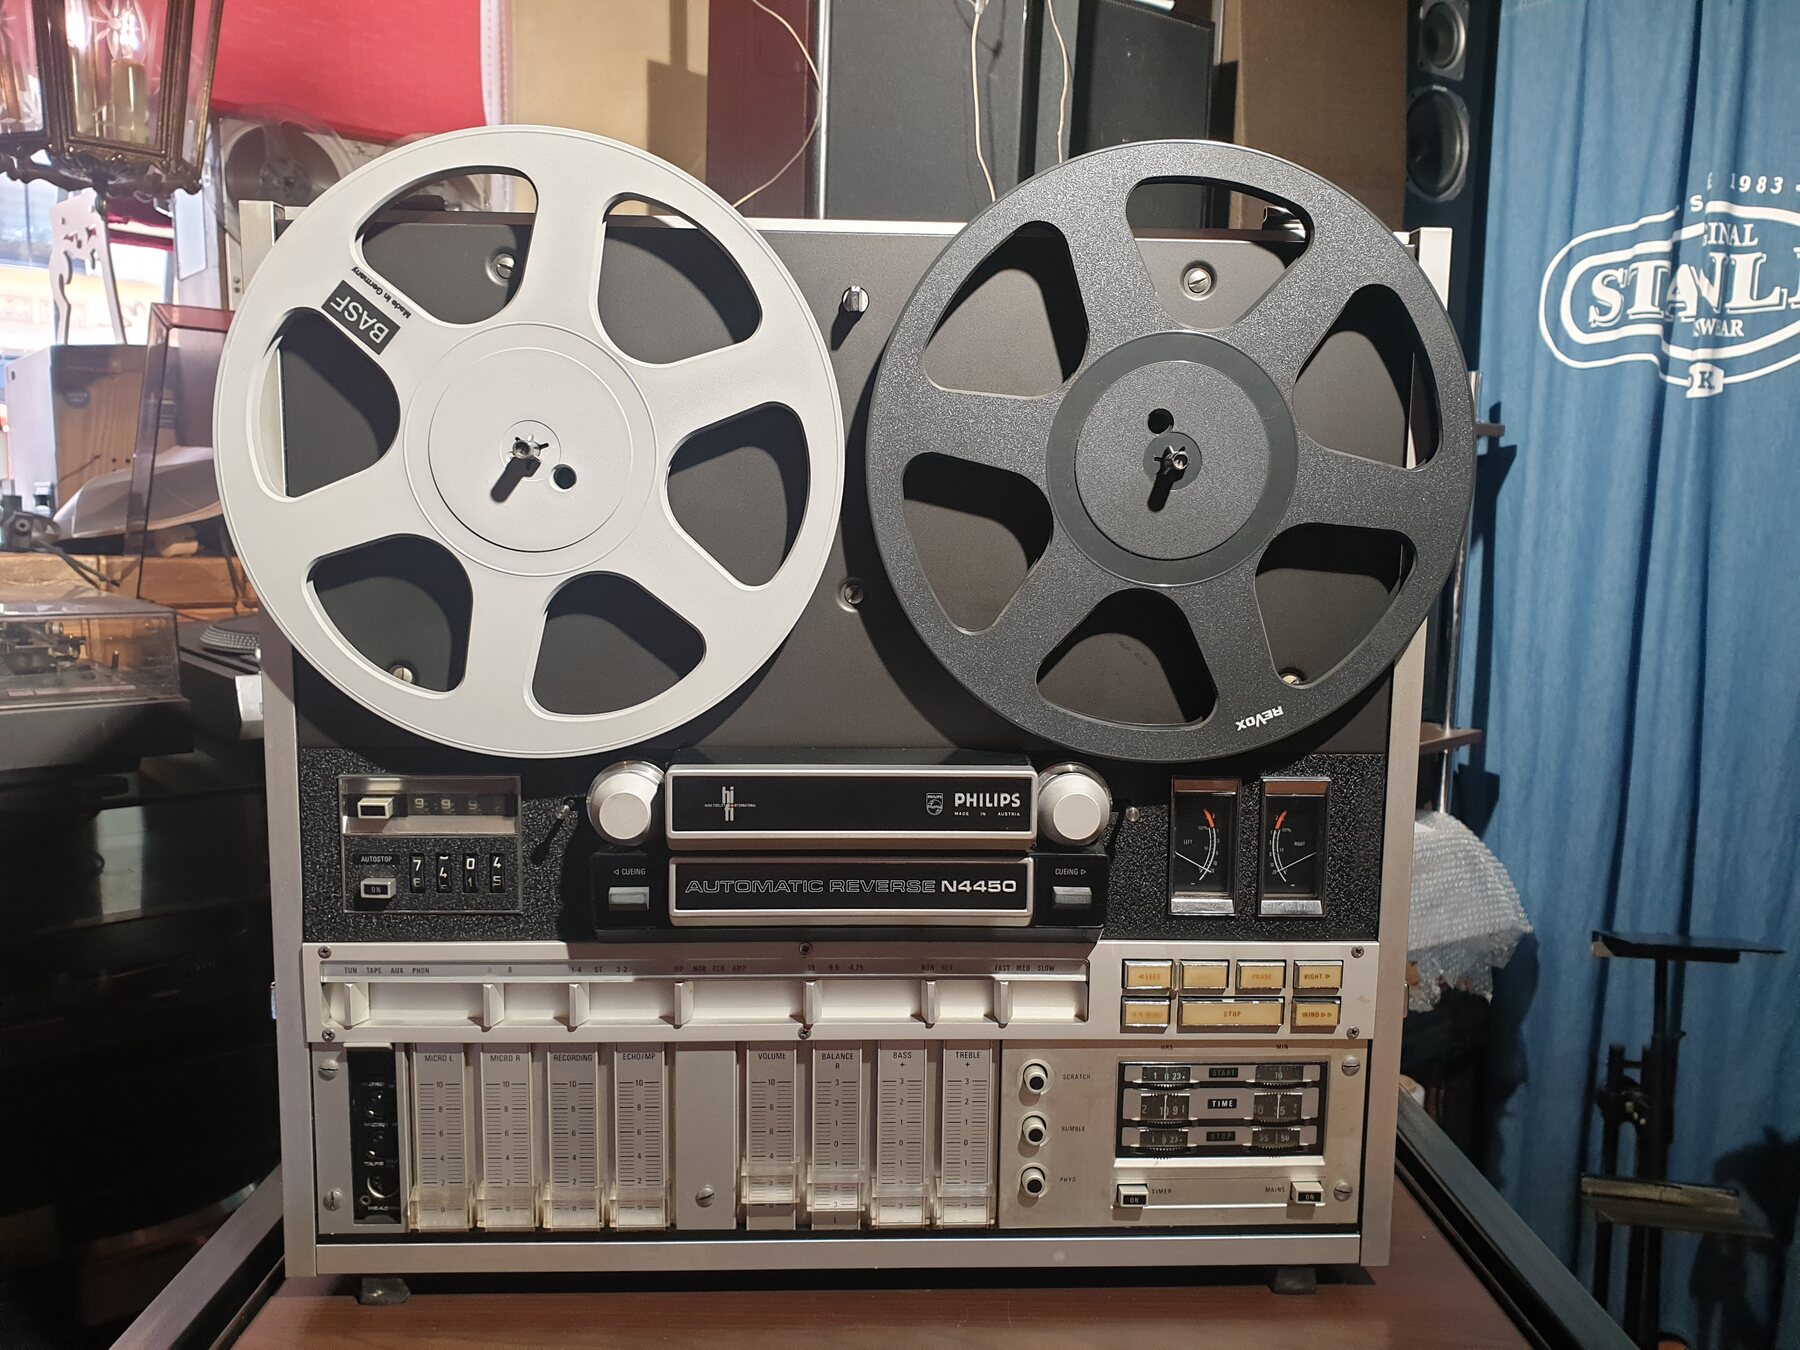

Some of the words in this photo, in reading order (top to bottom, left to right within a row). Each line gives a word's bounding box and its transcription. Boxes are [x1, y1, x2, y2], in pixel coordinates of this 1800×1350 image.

[351, 266, 384, 296] Germany
[391, 300, 412, 319] Made
[330, 296, 390, 344] BASF
[954, 792, 1021, 808] PHILIPS
[621, 868, 646, 876] CUEING
[1054, 868, 1079, 876] CUEING
[685, 880, 824, 893] AUTOMATIC
[829, 880, 936, 893] REVERSE
[941, 880, 1017, 893] N4450
[1212, 1100, 1233, 1108] TIME
